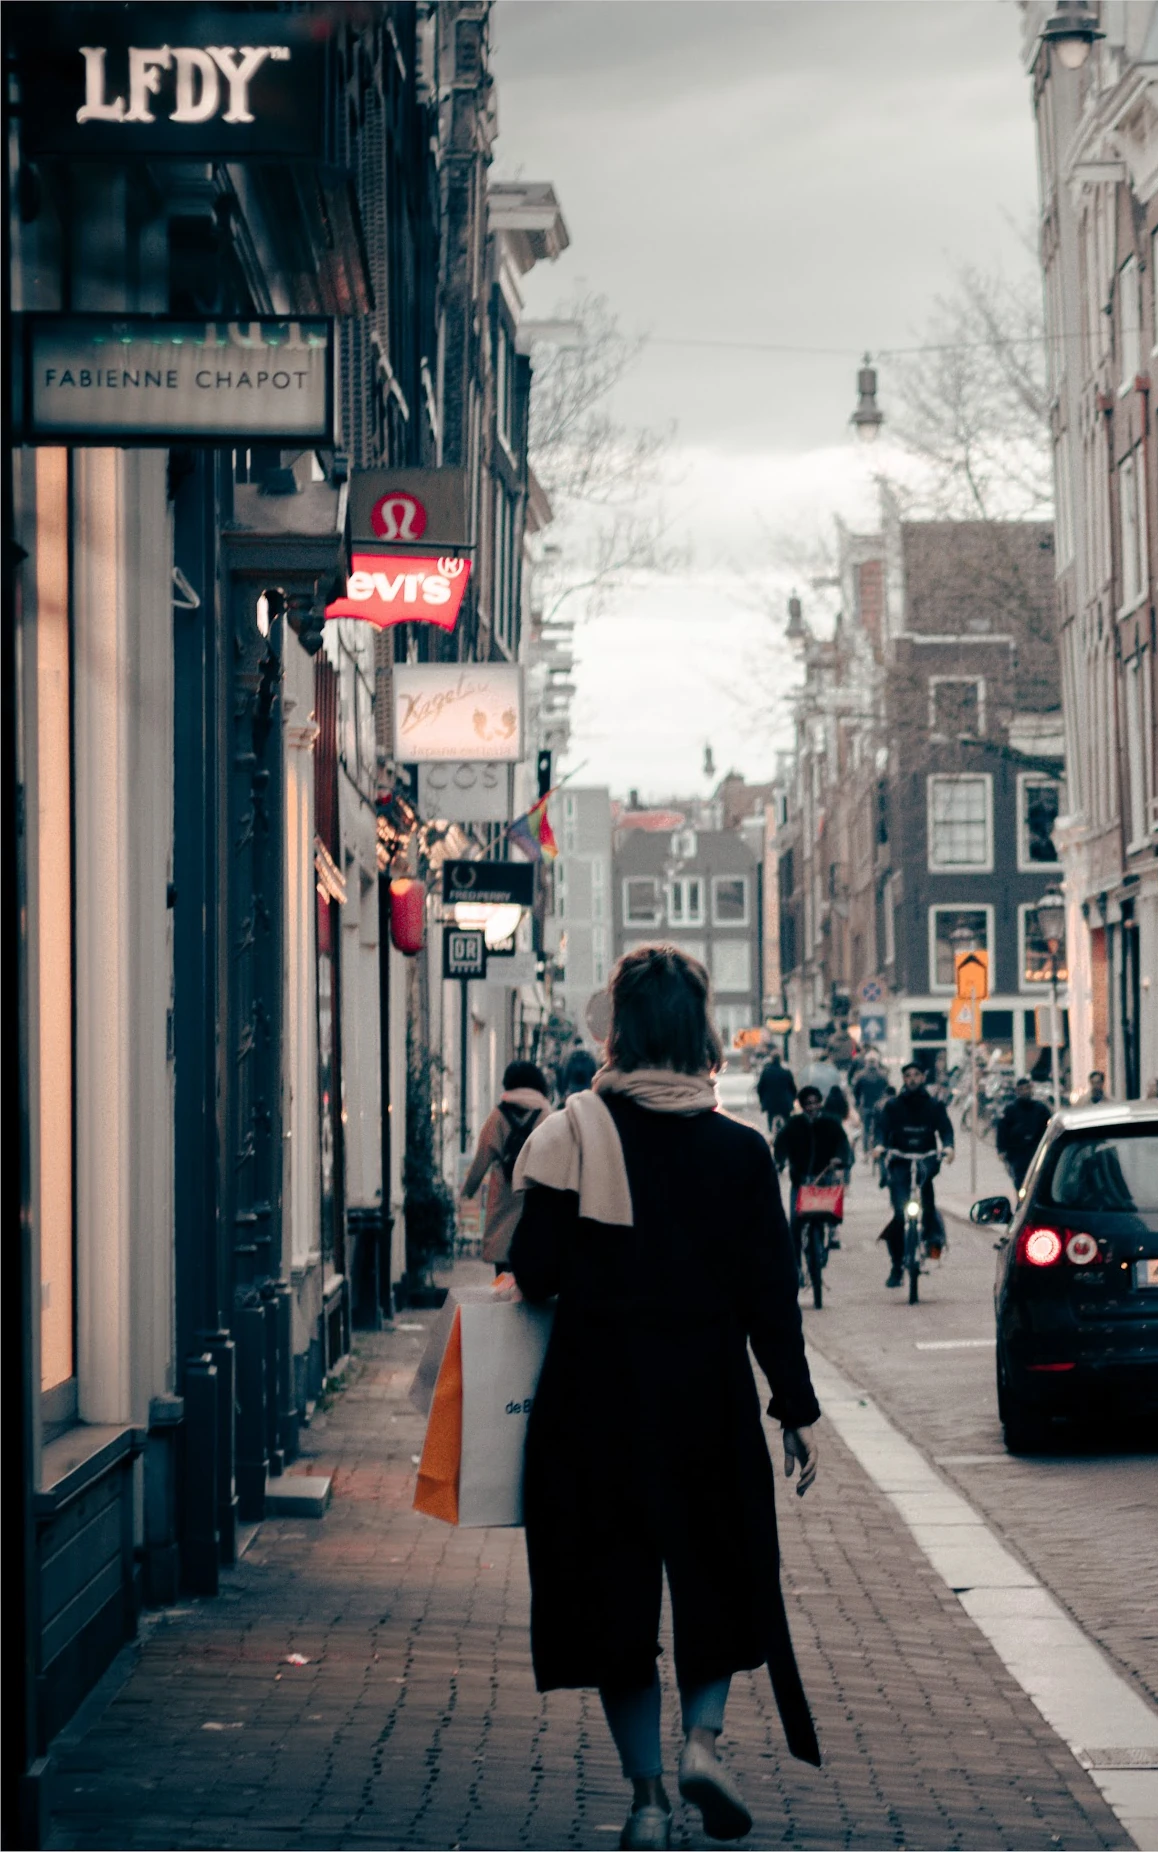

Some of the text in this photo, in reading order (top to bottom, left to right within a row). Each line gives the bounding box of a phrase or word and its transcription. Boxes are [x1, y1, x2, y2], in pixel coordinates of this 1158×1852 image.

[45, 369, 309, 390] FABIENNE CHAPOT
[426, 765, 499, 789] COS
